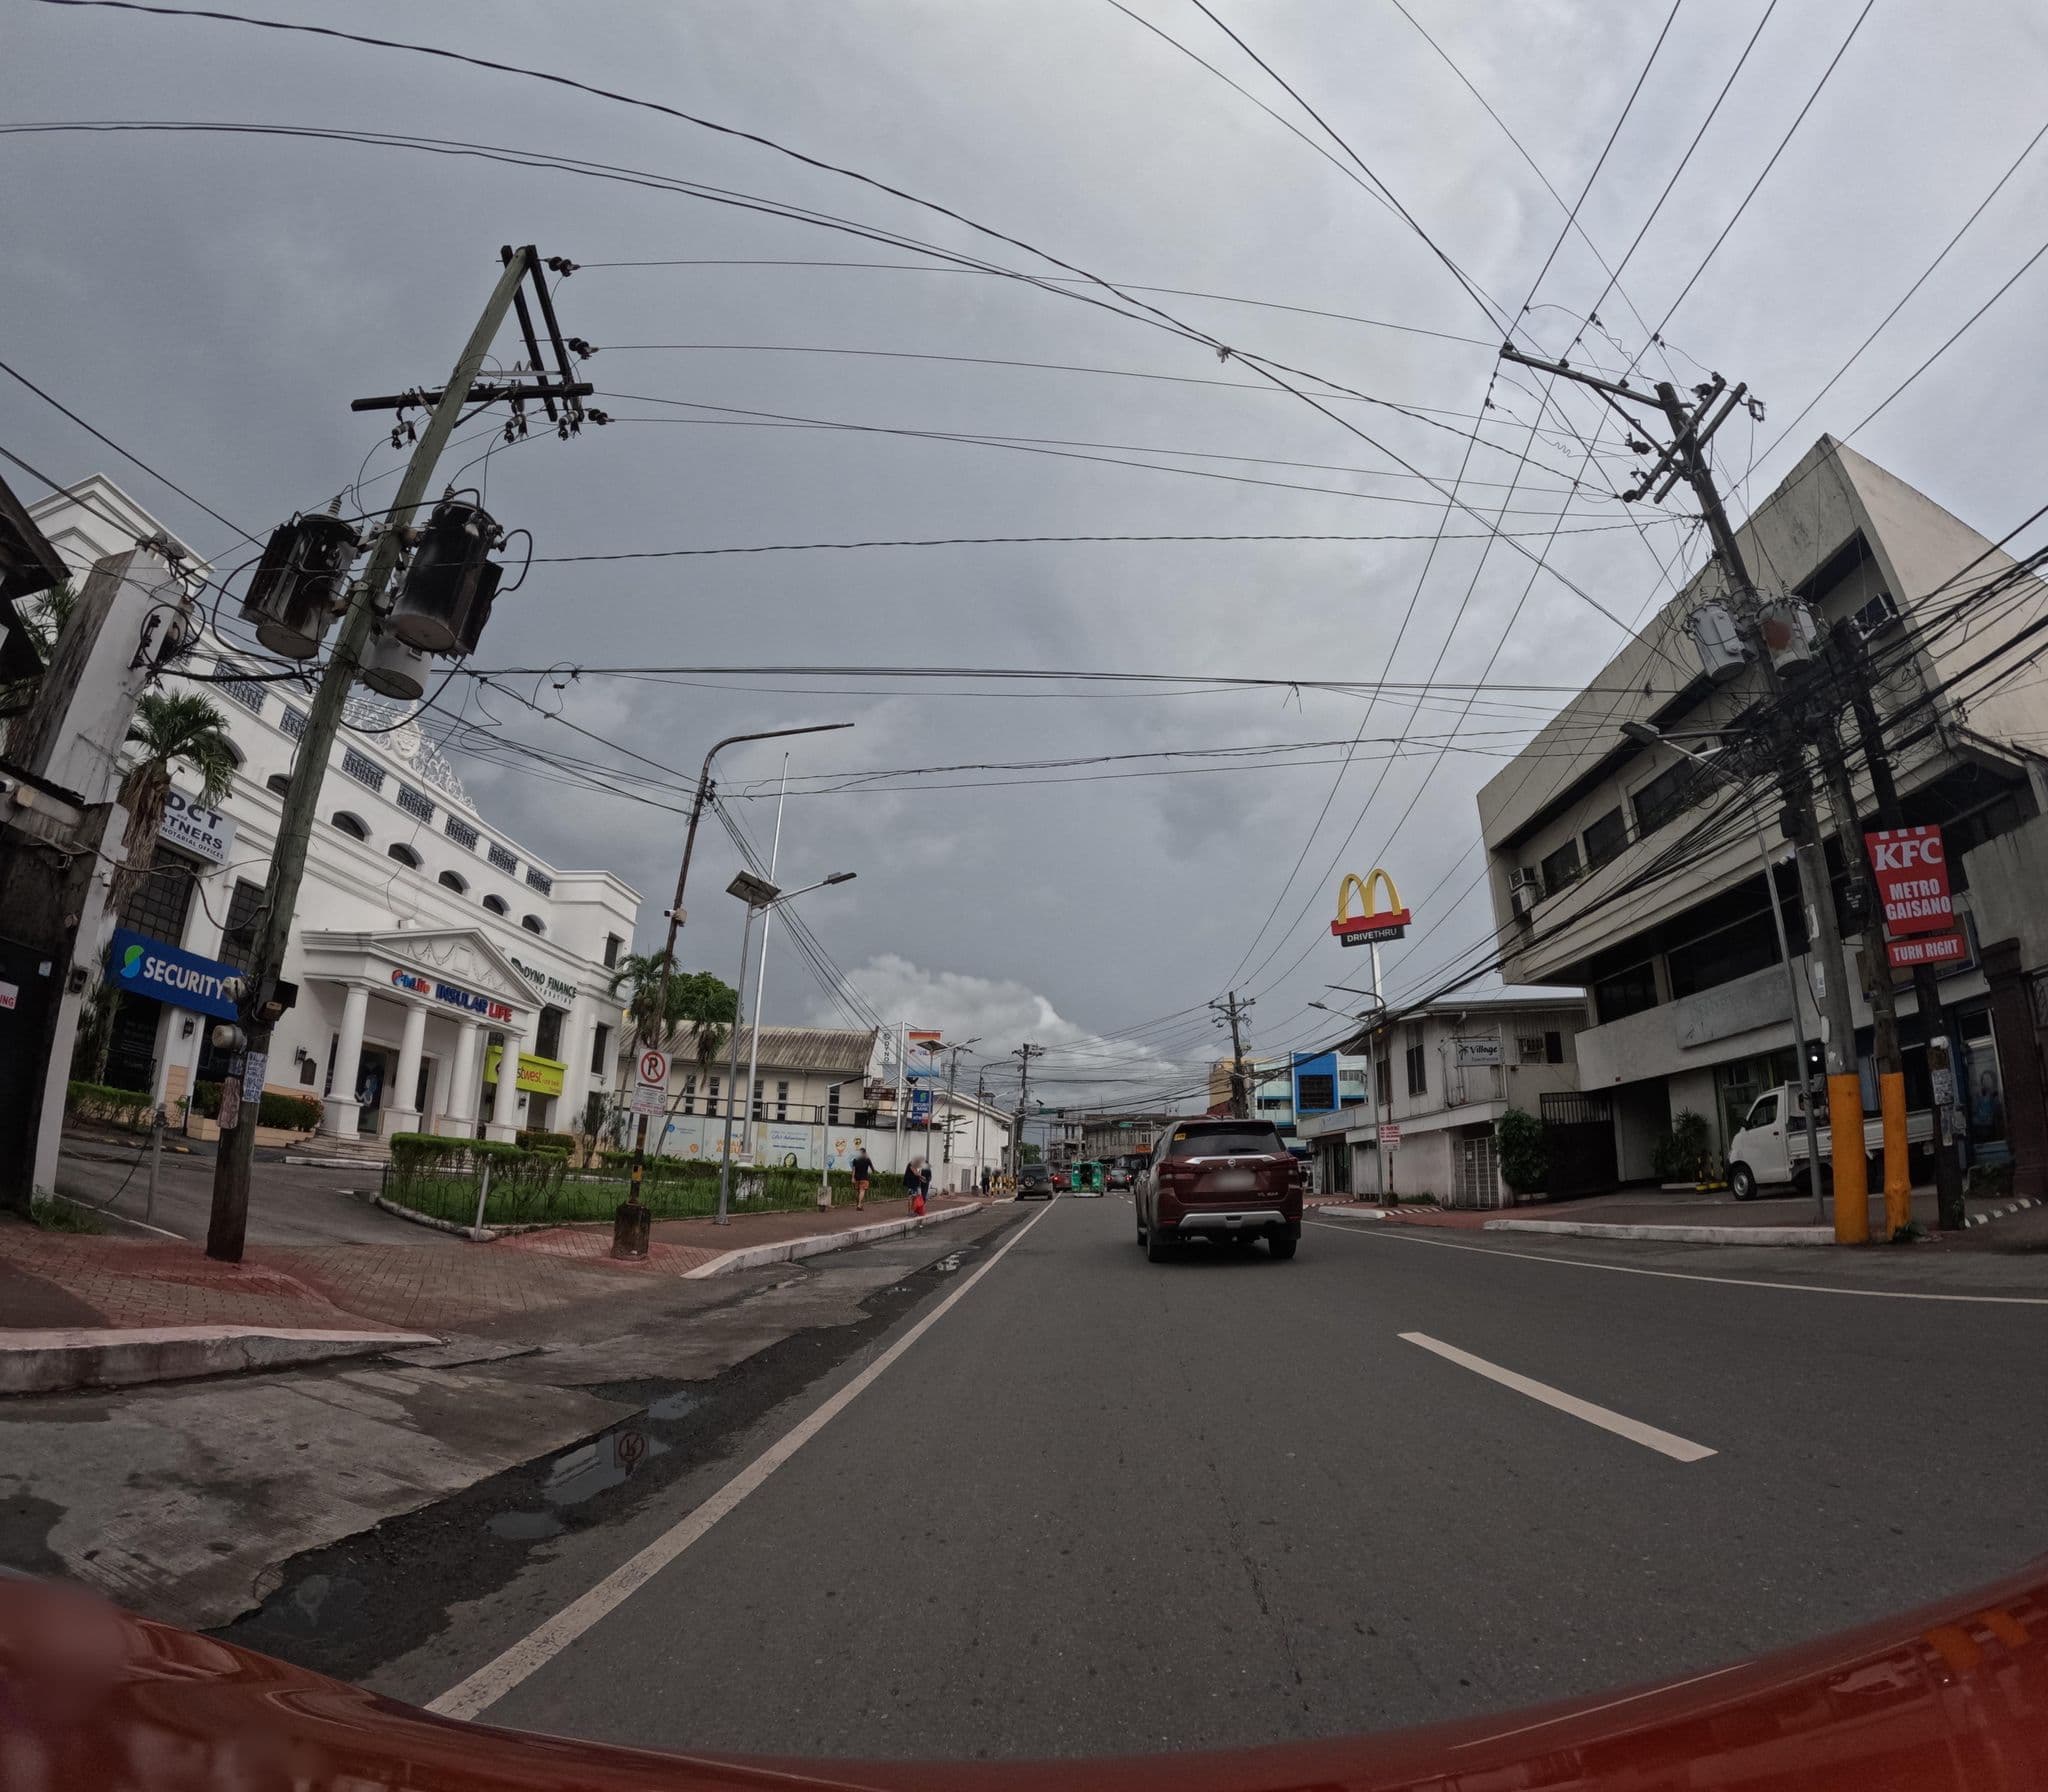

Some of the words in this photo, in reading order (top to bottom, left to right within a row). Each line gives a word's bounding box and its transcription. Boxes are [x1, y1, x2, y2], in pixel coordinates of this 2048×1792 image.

[198, 844, 224, 860] OFFICES
[1875, 837, 1942, 871] KFC
[1889, 879, 1940, 901] METRO
[1885, 896, 1952, 920] GAISANO
[1893, 943, 1924, 961] TURN
[1925, 939, 1959, 958] RIGHT
[143, 956, 226, 1000] SECURITY
[523, 966, 545, 985] DYNO
[546, 976, 577, 999] FINANCE
[436, 983, 488, 1014] INSULAR
[488, 1002, 513, 1023] LIFE
[1470, 1045, 1498, 1056] Village
[517, 1066, 543, 1084] stwest
